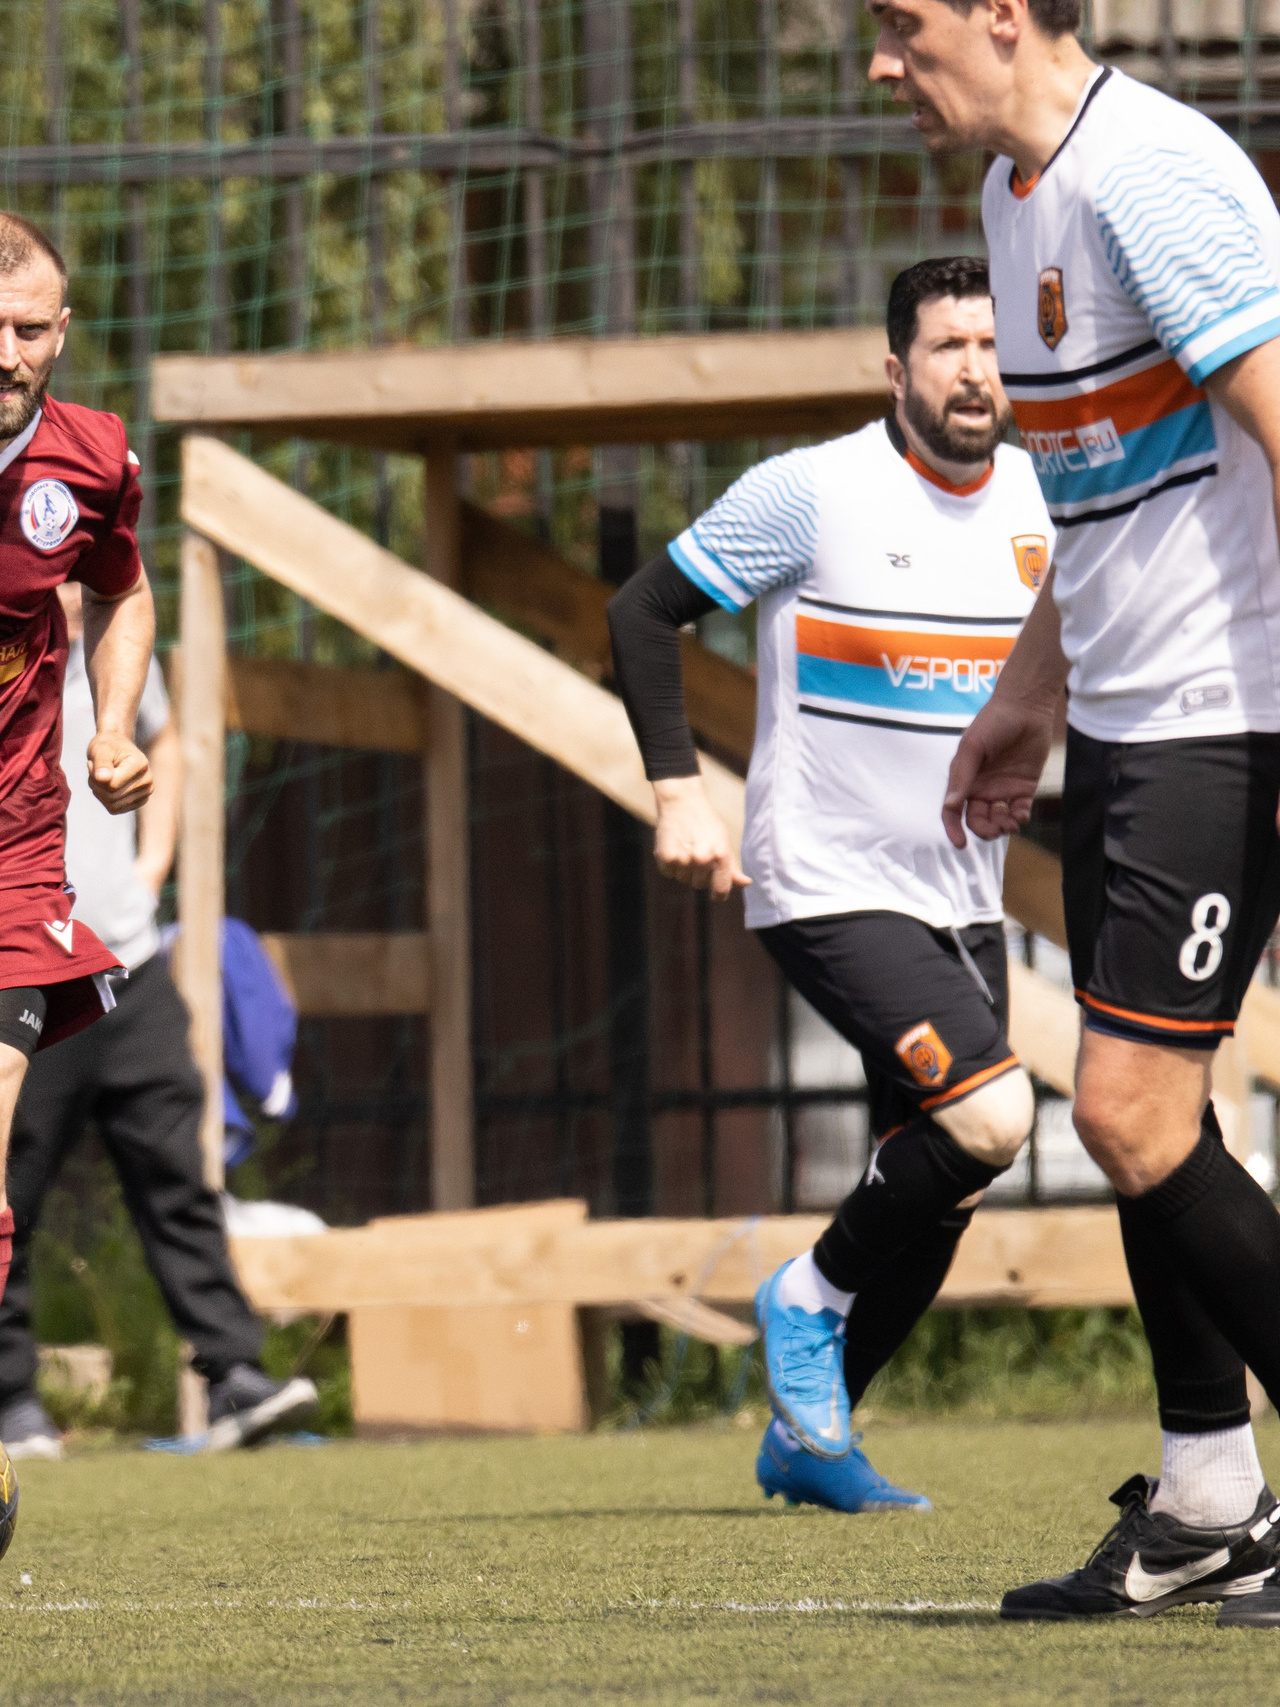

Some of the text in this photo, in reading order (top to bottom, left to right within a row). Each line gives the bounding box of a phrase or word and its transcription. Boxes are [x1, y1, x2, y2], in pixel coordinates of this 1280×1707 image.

[1020, 429, 1088, 475] ORTE
[1178, 892, 1231, 982] 8
[18, 1009, 44, 1036] JAK
